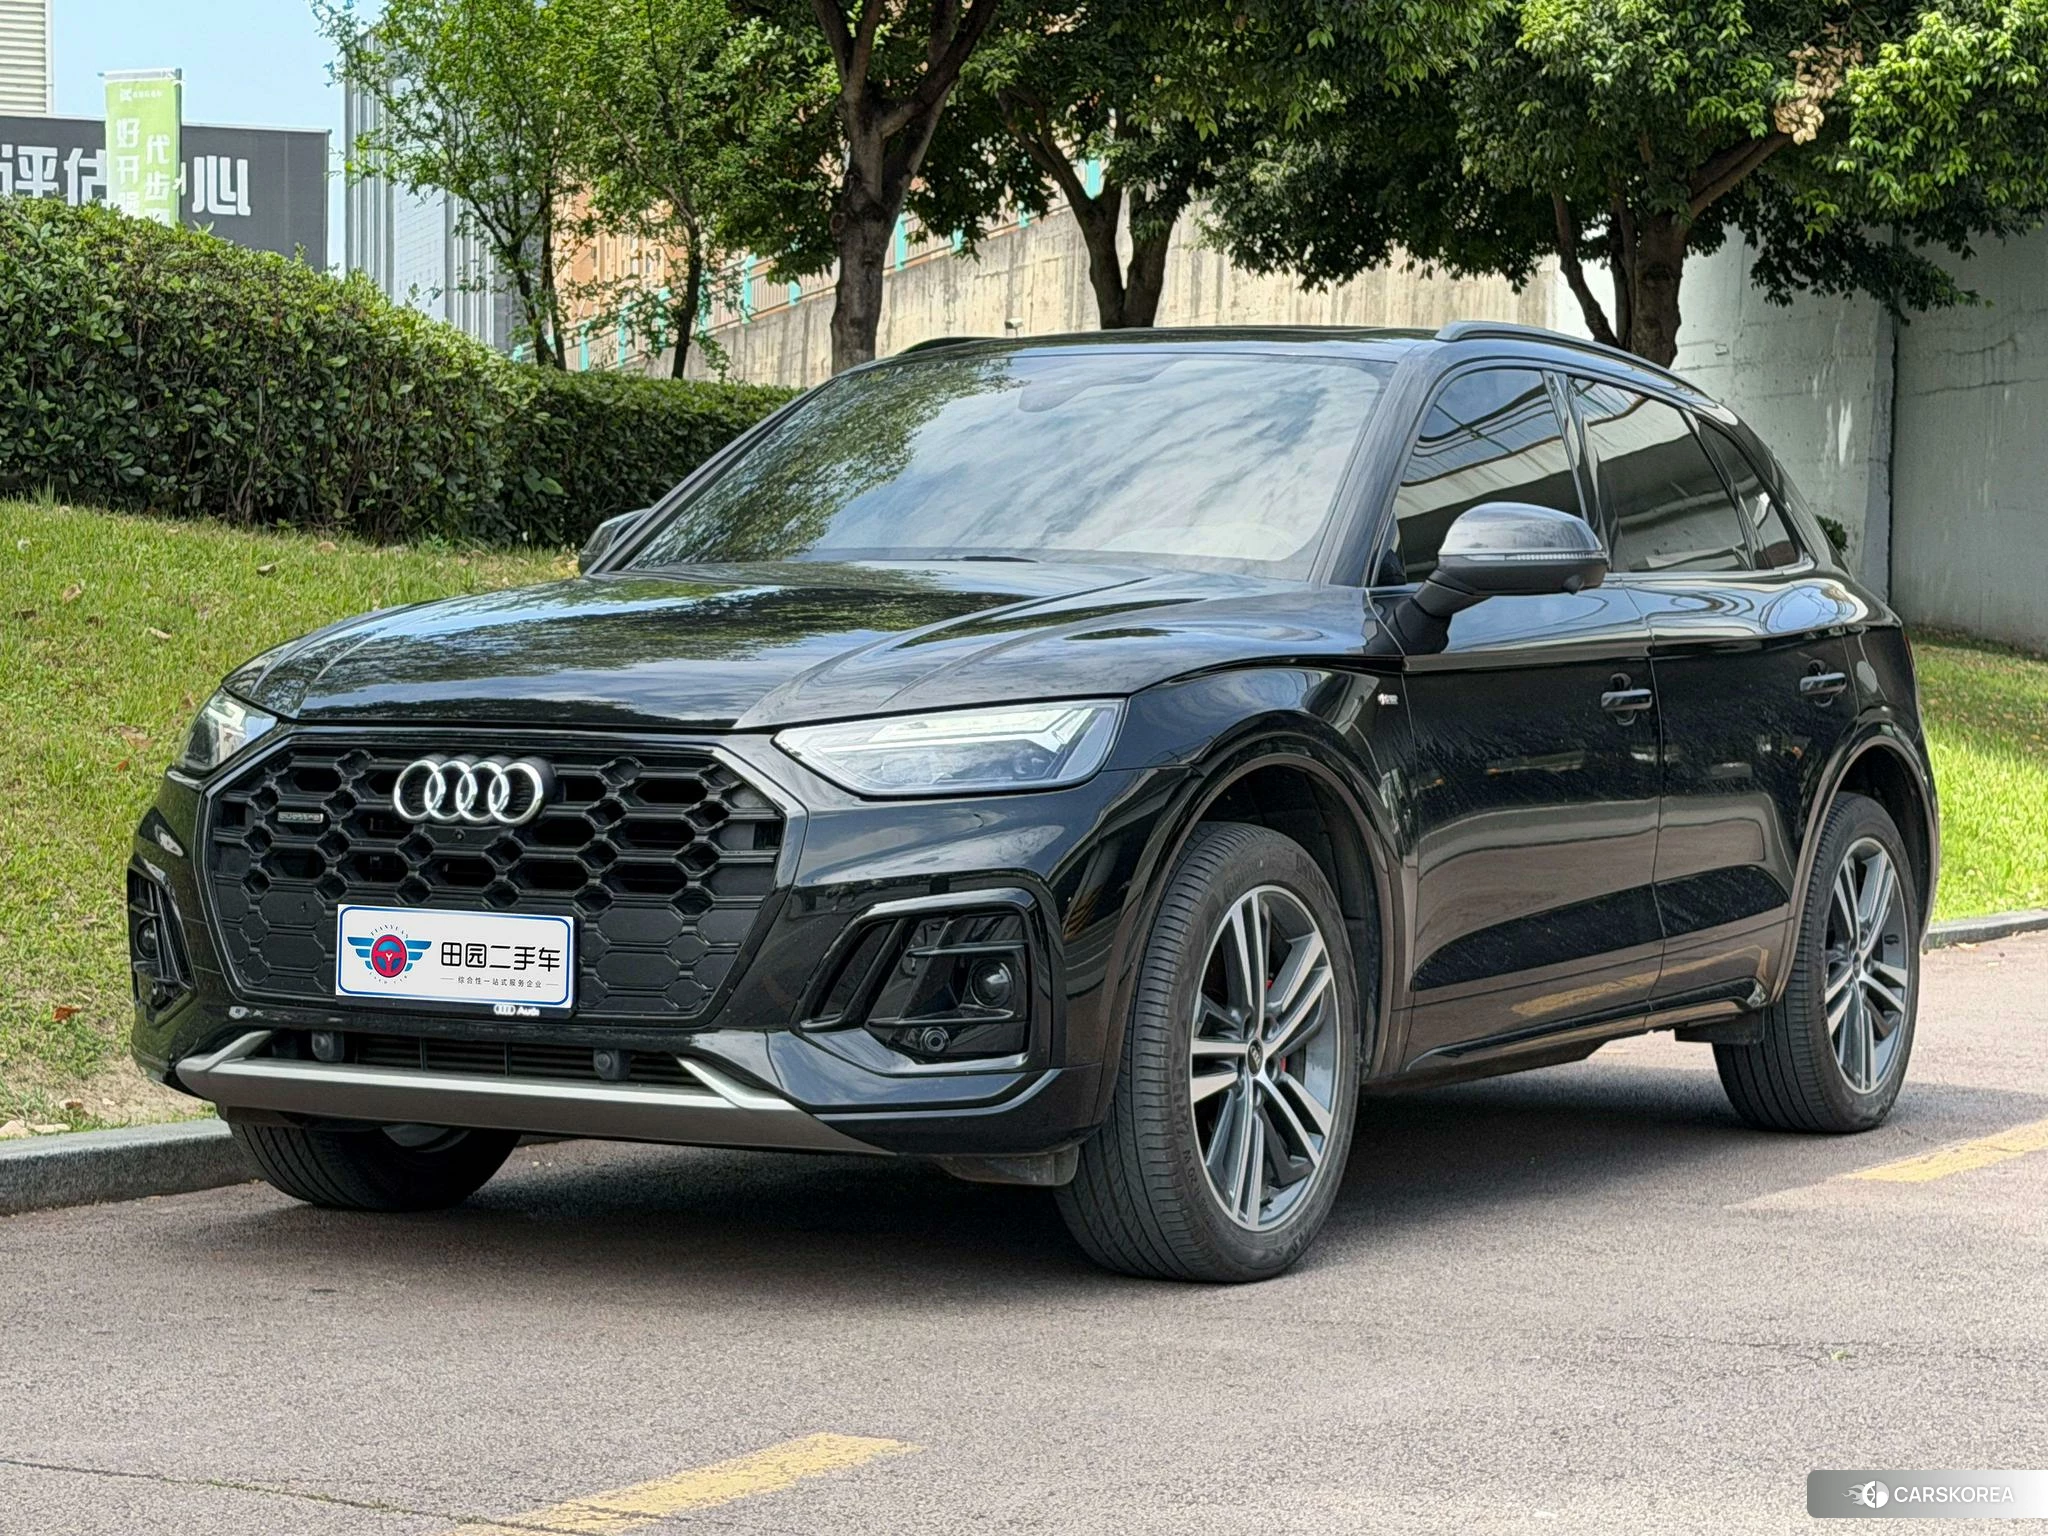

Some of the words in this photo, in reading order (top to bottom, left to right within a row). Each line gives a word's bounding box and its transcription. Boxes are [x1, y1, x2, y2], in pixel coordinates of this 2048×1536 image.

[0, 143, 251, 217] 评估心
[441, 942, 561, 972] 田园二手车
[458, 976, 542, 989] 综合性一站式服务企业
